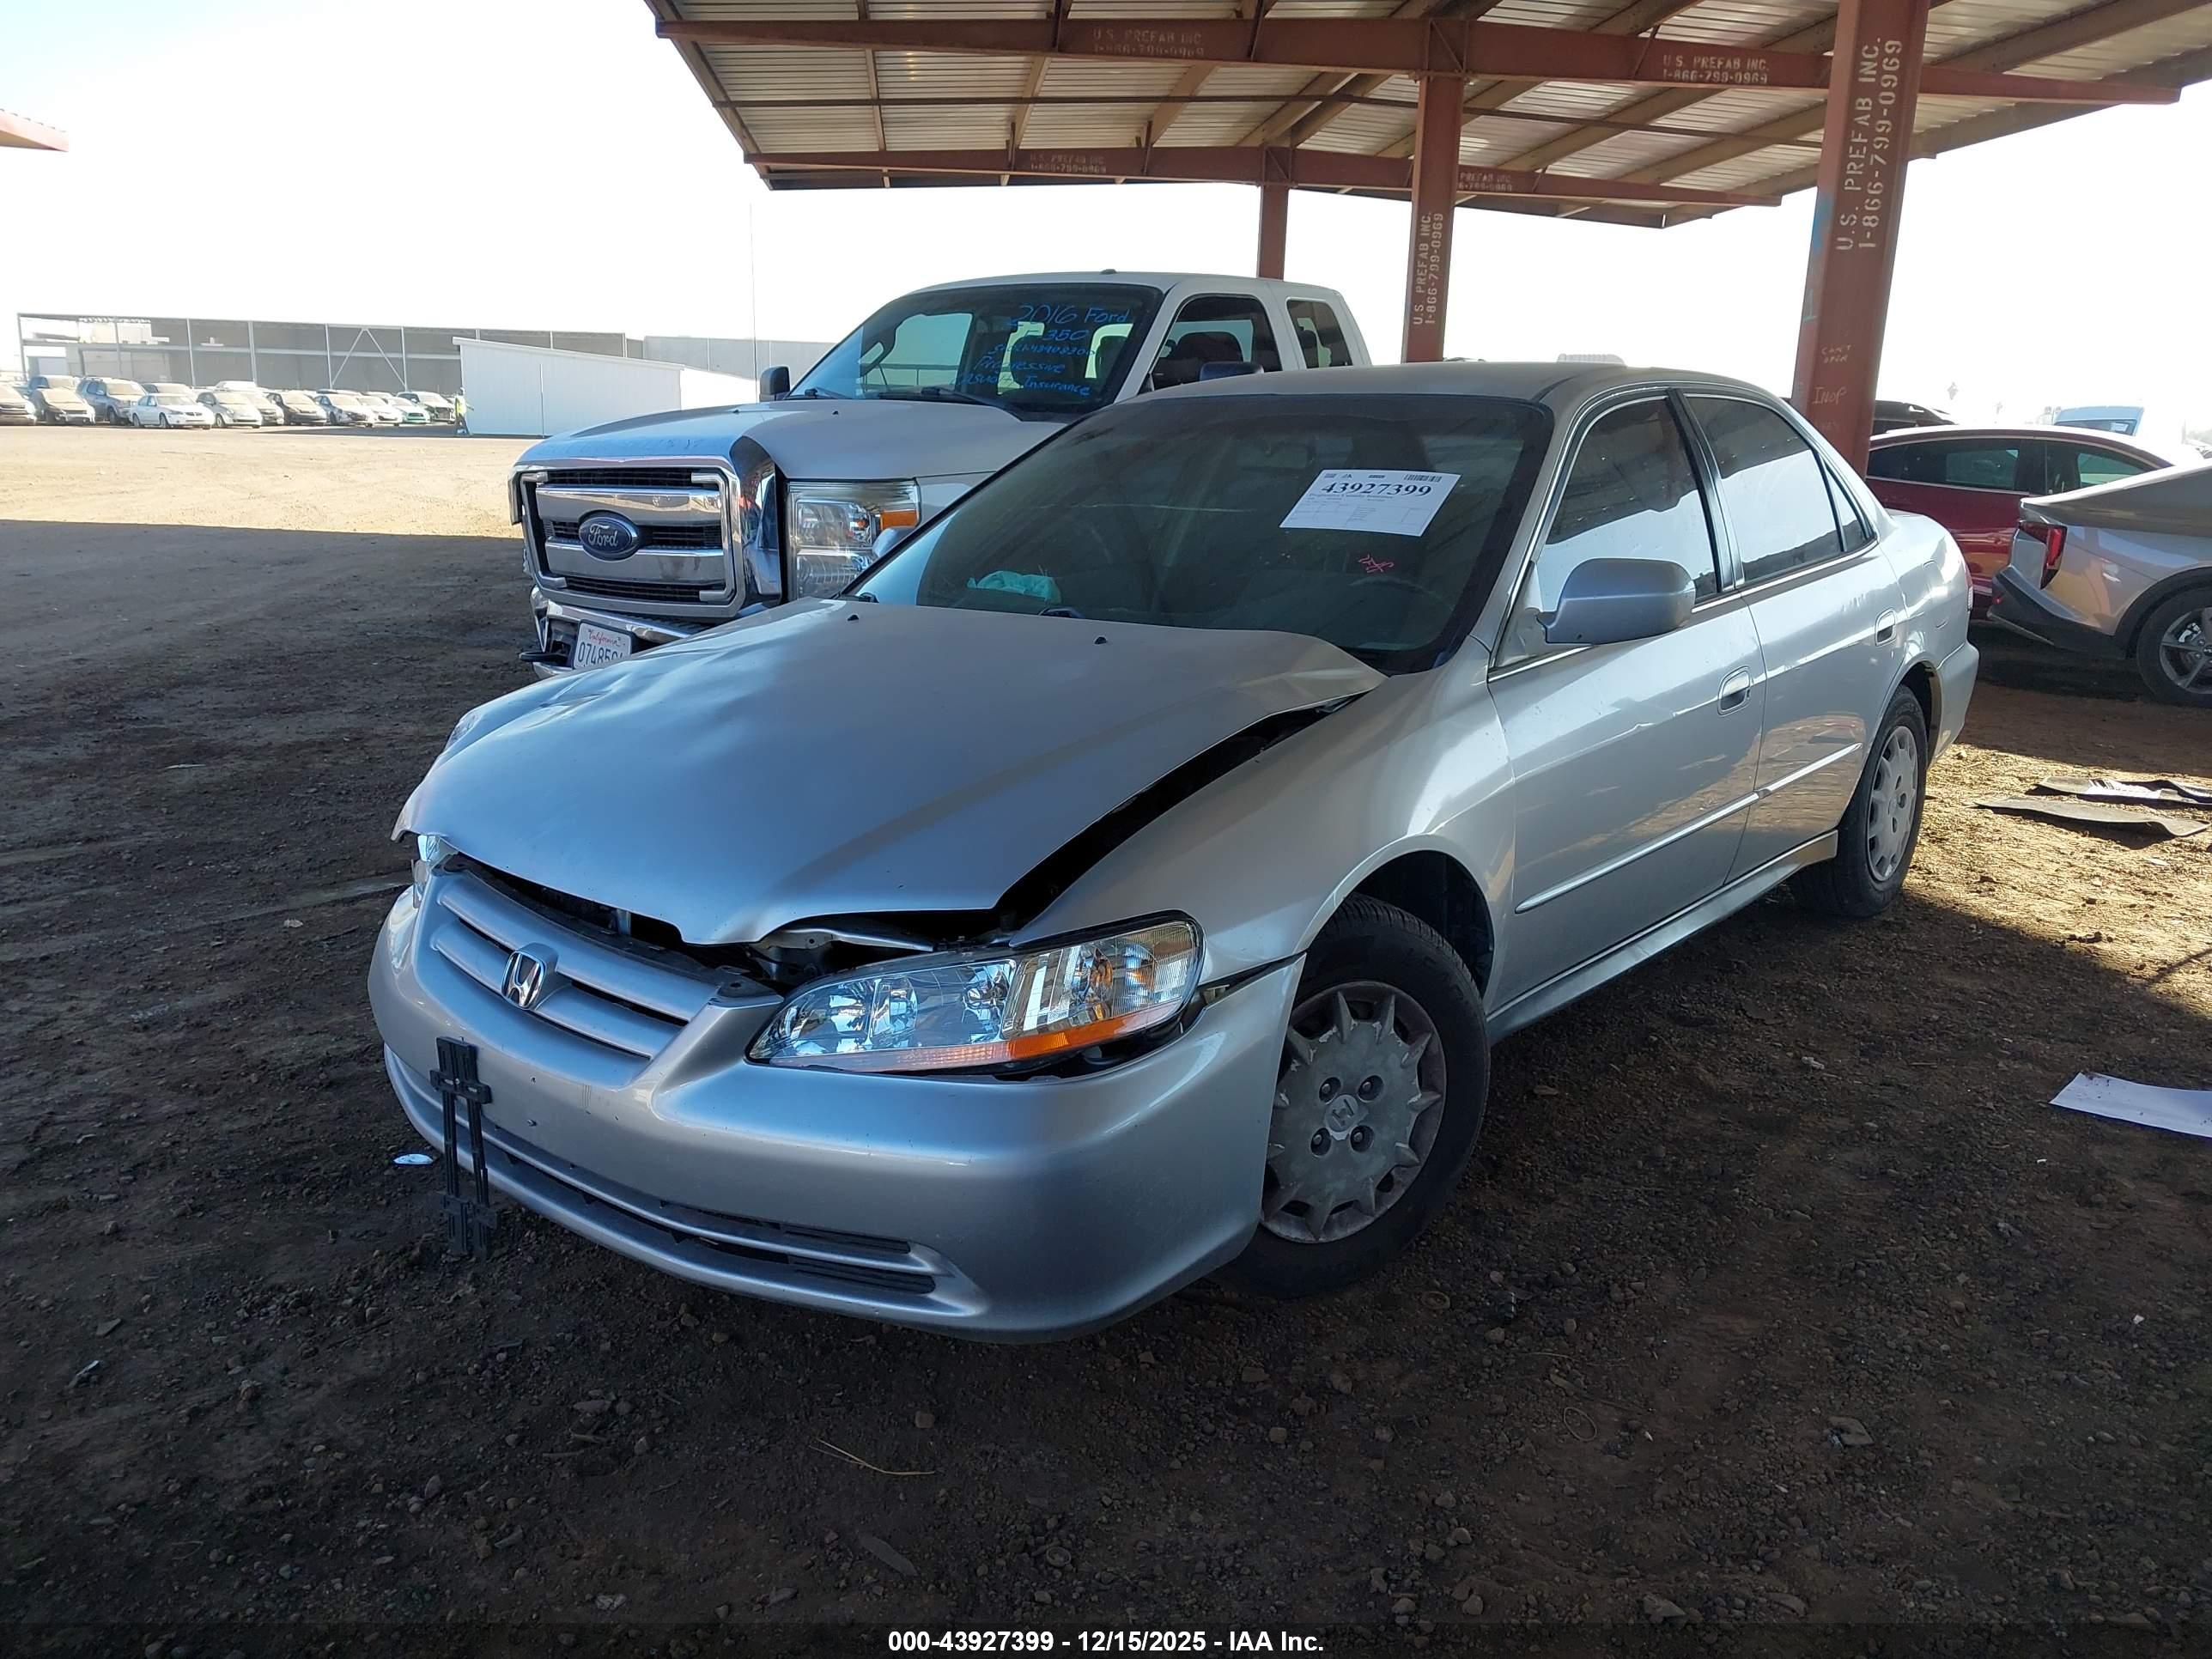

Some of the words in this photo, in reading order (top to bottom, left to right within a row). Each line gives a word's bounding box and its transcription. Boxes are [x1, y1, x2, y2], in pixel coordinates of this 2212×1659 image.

[1692, 56, 1741, 70] PREFAB
[1857, 37, 1881, 83] INC.
[1844, 96, 1874, 191] PREFAB
[1858, 40, 1903, 249] 1-866-799-0969
[1419, 212, 1431, 236] INC.
[1836, 208, 1860, 251] U.S.
[1415, 242, 1430, 294] PREFAB
[1424, 212, 1444, 325] 1-866-799-0969
[1012, 303, 1078, 325] 2016
[1085, 307, 1131, 324] Ford
[1321, 482, 1432, 497] 43927399
[588, 523, 618, 547] Ford
[588, 629, 621, 647] California
